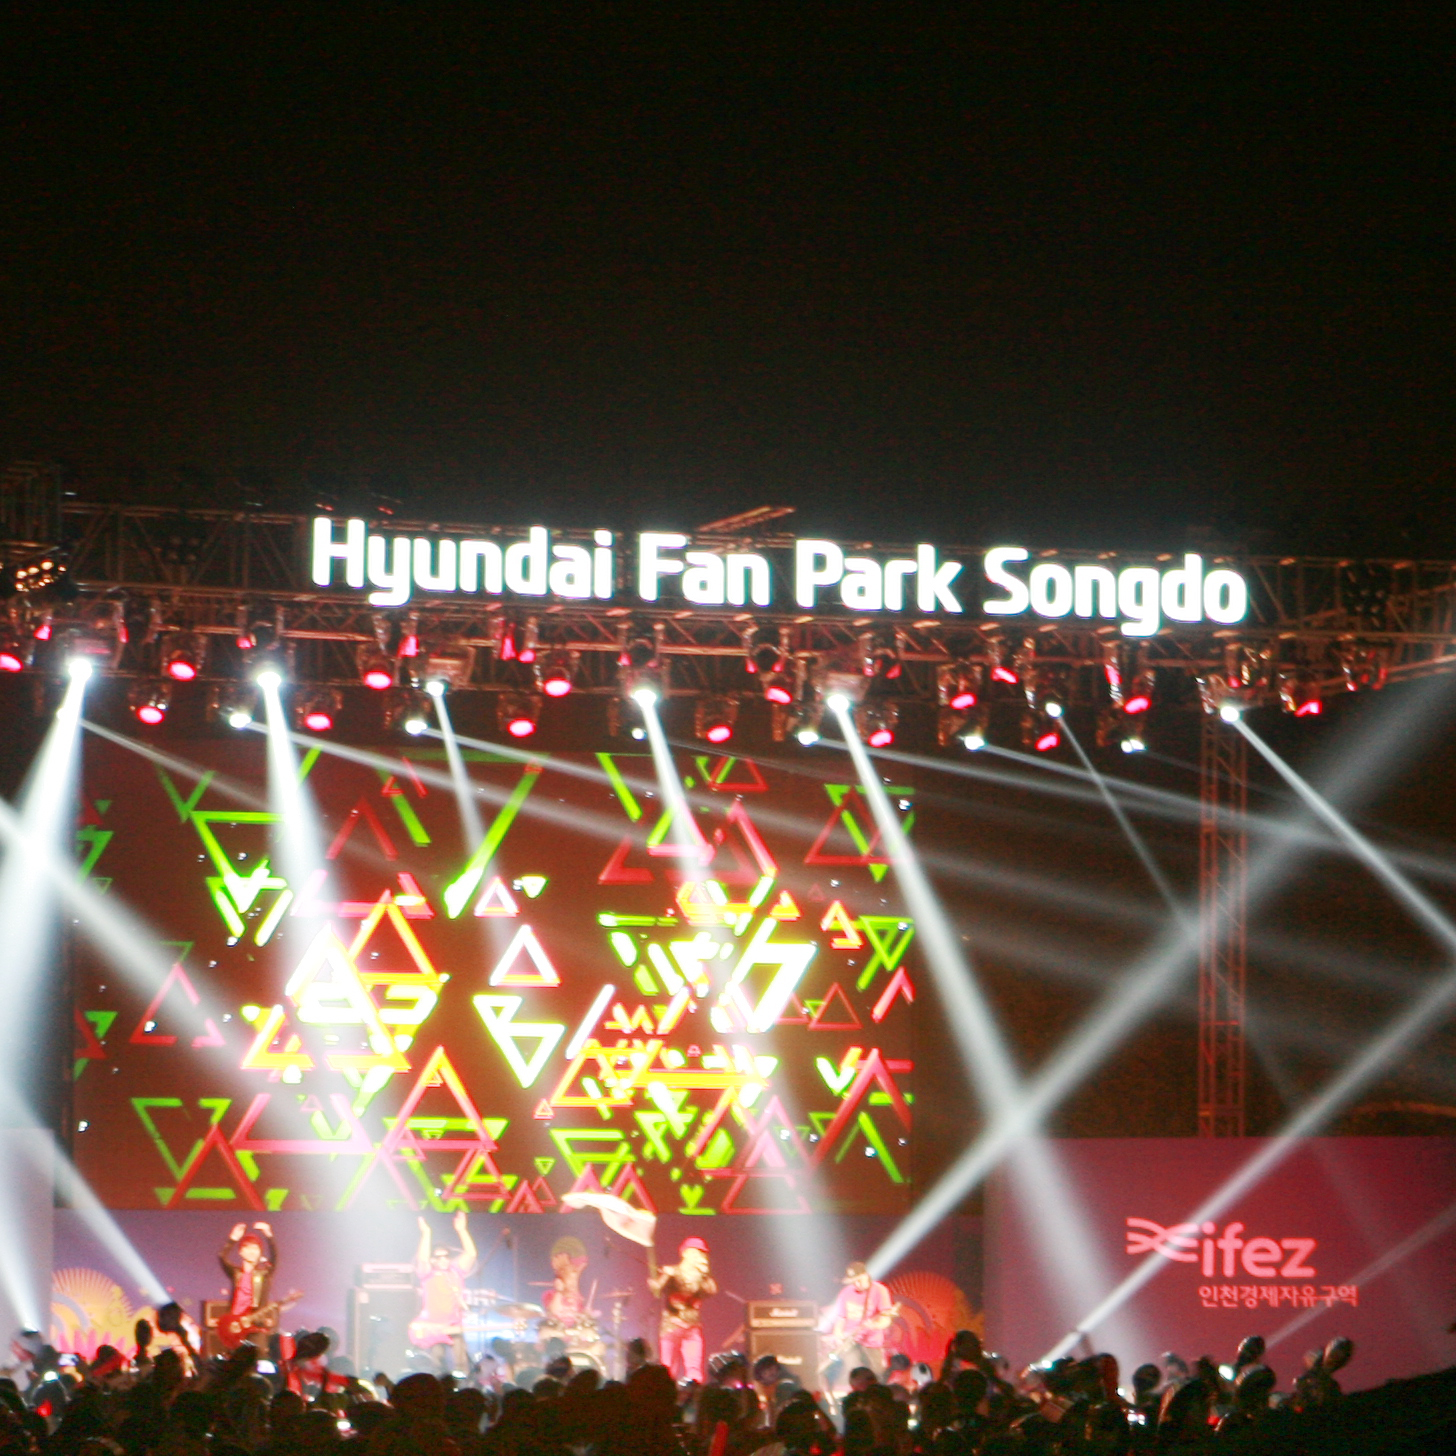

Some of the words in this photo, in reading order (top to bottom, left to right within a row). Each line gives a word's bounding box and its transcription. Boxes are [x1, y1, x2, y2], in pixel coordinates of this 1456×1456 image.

[312, 516, 613, 607] Hyundai
[637, 531, 771, 607] Fan
[795, 538, 964, 614] Park
[982, 545, 1248, 638] Songdo
[1201, 1221, 1317, 1278] ifez
[1198, 1284, 1359, 1309] 인천경제자유구역
